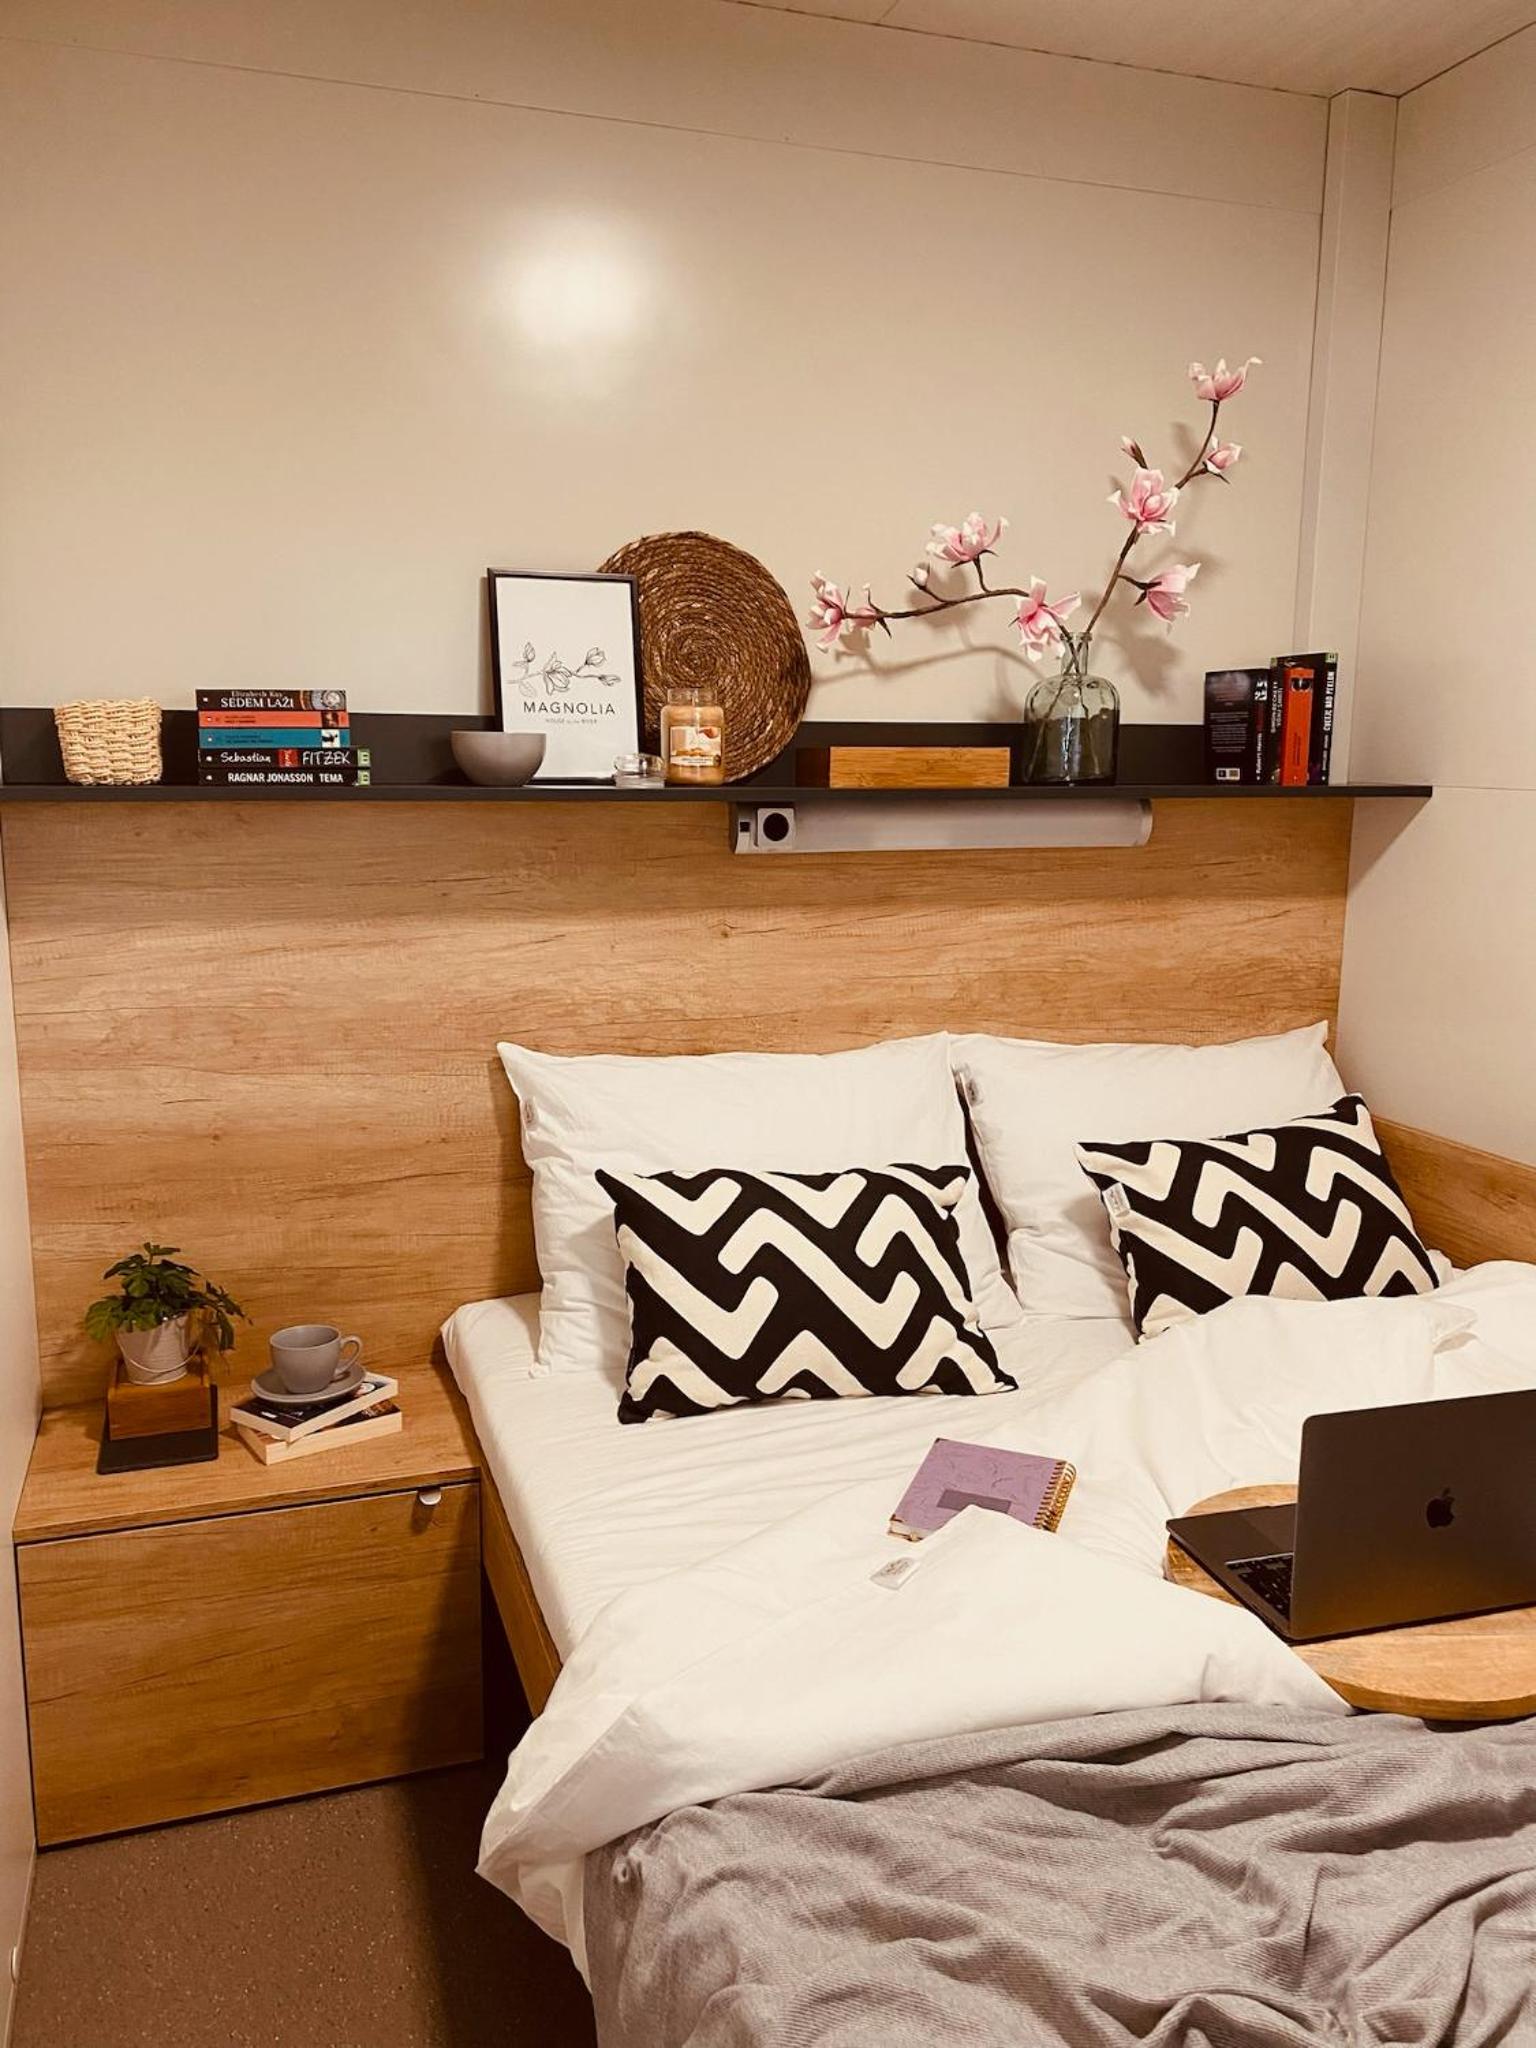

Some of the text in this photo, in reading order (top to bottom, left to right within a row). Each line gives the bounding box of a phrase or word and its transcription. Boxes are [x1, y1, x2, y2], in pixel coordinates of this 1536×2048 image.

[221, 697, 264, 708] SEDEM
[523, 701, 615, 715] MAGNOLIA
[220, 751, 271, 763] Sebastian
[302, 750, 351, 766] FITZEK
[227, 772, 344, 783] RAGNAR JONASSON TEMA
